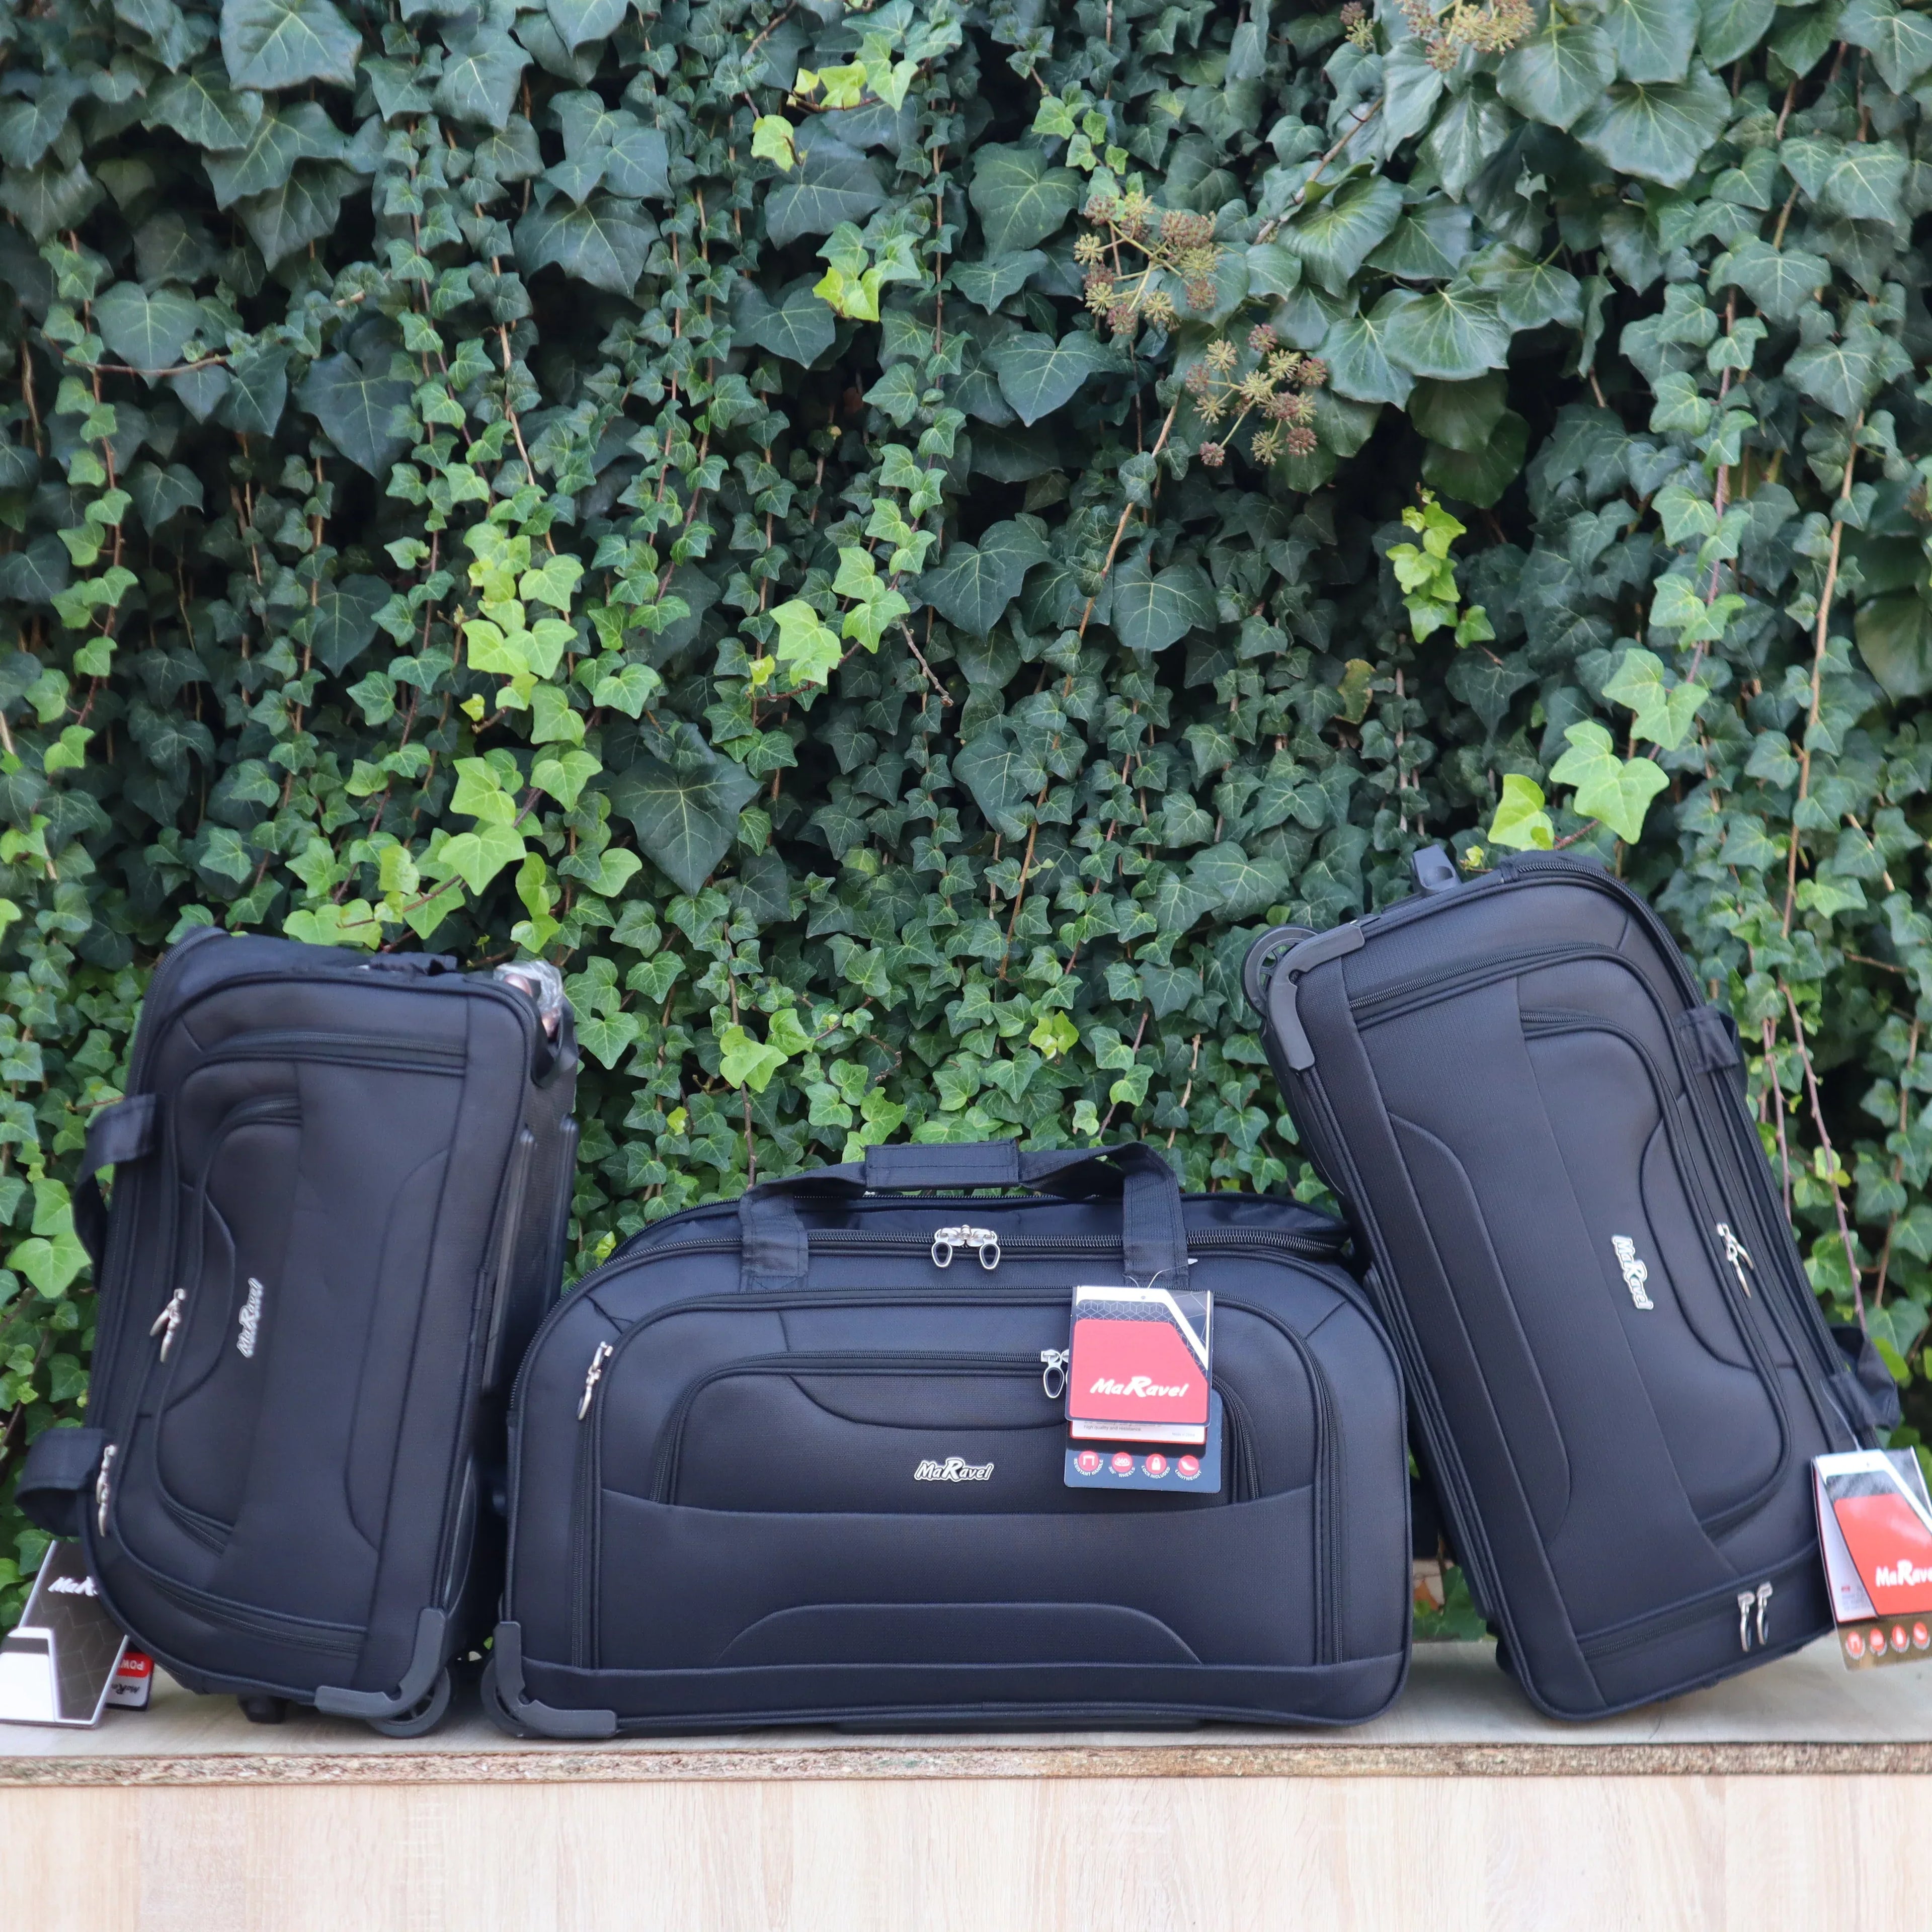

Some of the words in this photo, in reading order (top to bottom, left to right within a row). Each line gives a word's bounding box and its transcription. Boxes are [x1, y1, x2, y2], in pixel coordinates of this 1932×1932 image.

[1612, 1235, 1654, 1310] MaRavel
[237, 1277, 263, 1357] MaRavel
[1090, 1376, 1189, 1398] MaRavel
[914, 1457, 994, 1482] MaRavel
[1073, 1459, 1091, 1476] RESISTANT
[1091, 1460, 1104, 1475] HANDLE
[1118, 1467, 1136, 1478] WHEELS
[1141, 1465, 1150, 1477] LOCK
[1150, 1467, 1170, 1479] INCLUDED
[1175, 1469, 1202, 1481] LIGHTWEIGHT
[1876, 1559, 1932, 1587] MaRave
